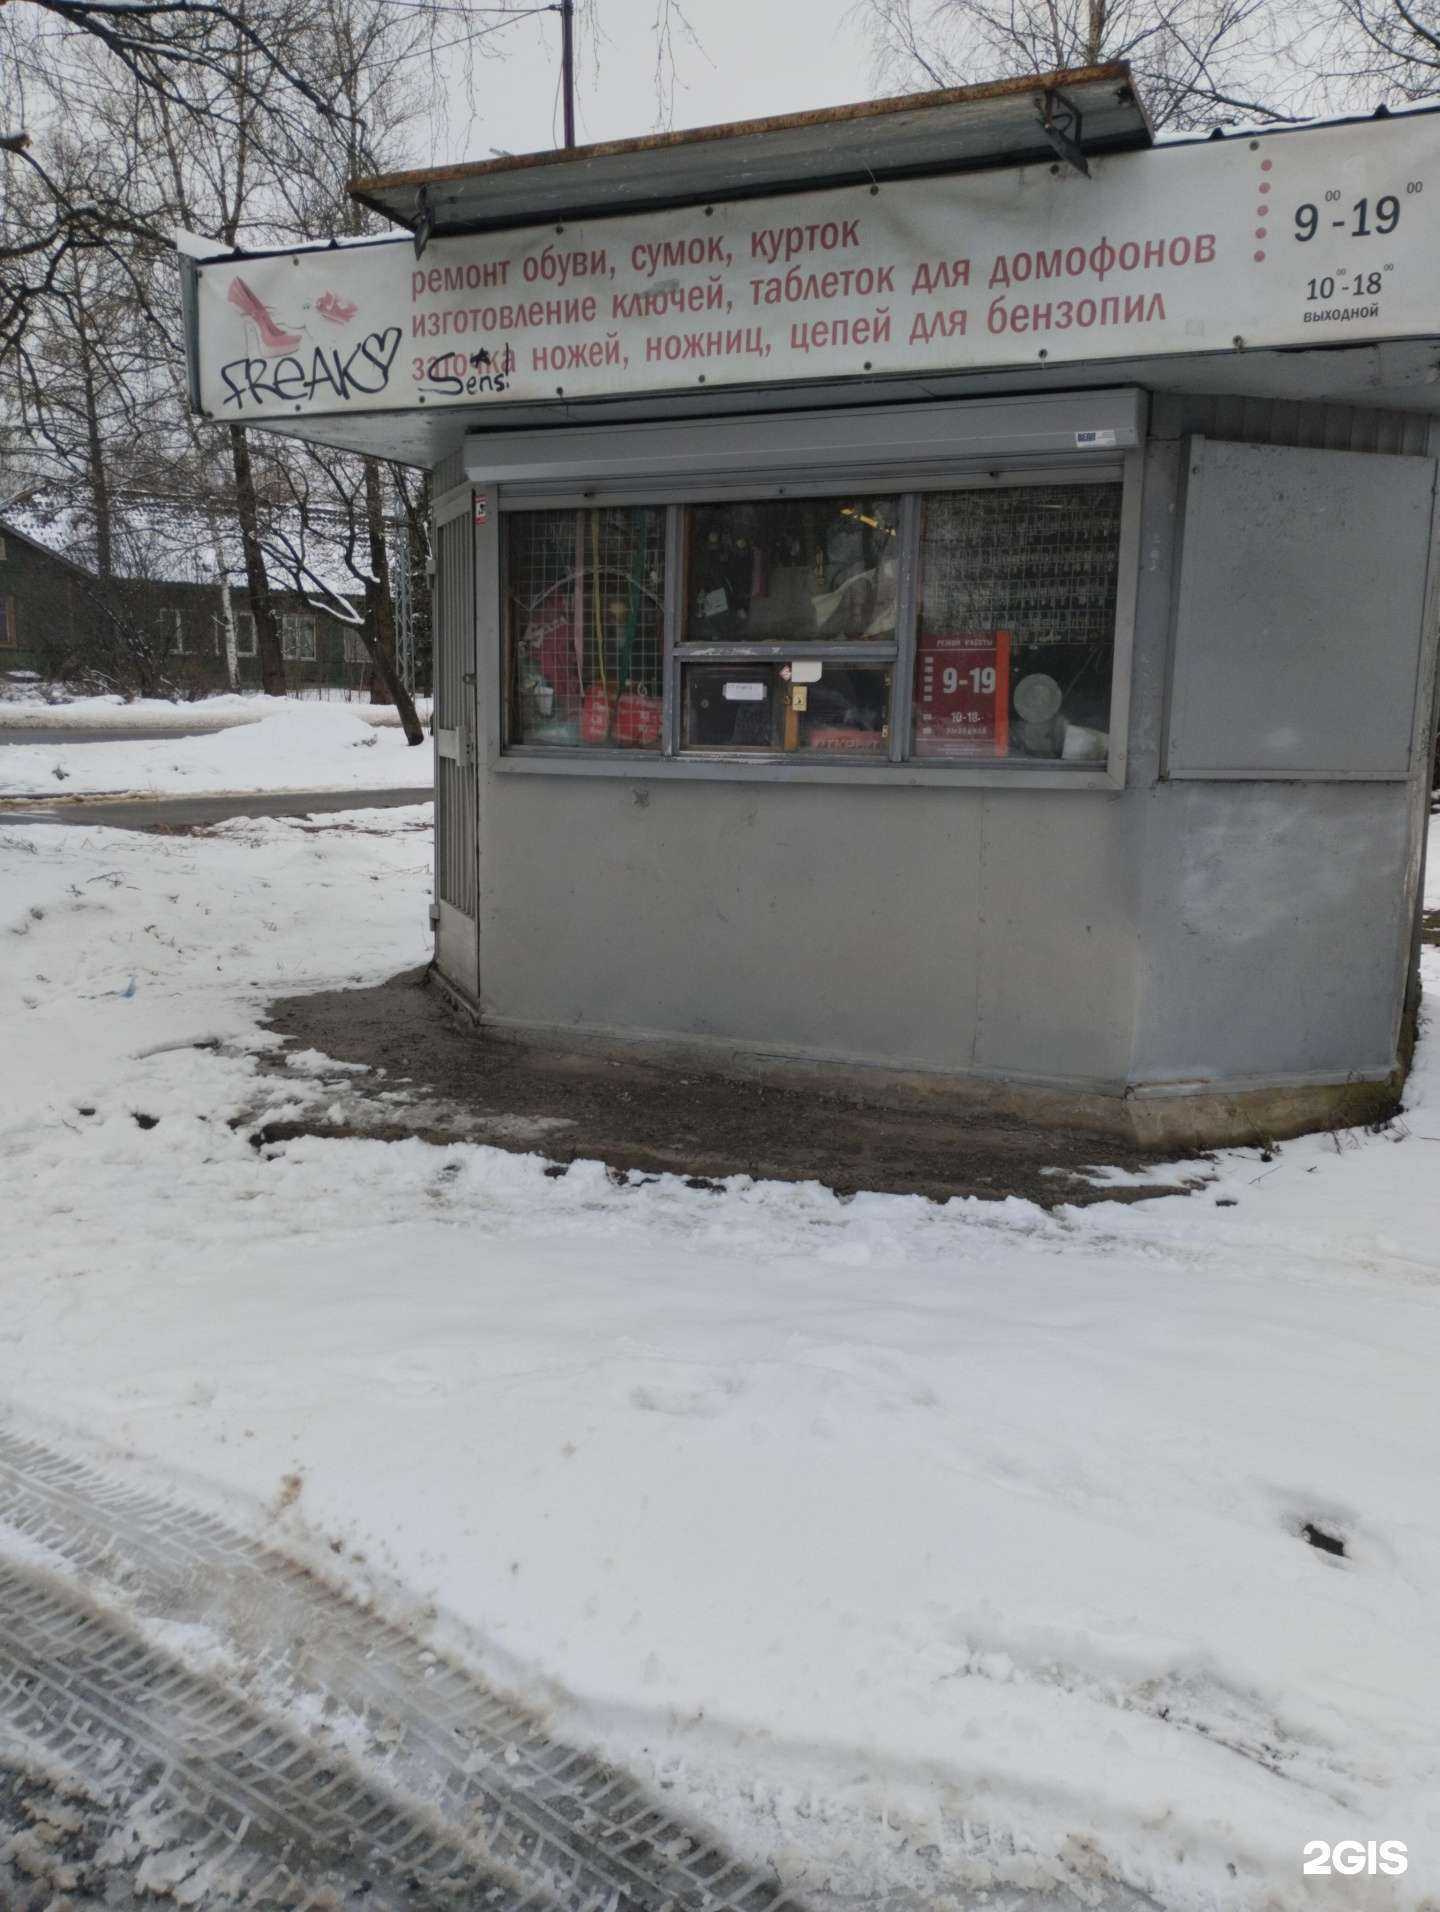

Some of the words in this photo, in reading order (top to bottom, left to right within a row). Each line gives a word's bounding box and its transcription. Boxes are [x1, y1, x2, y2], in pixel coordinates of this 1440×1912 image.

[411, 260, 511, 301] ремонт
[522, 245, 616, 287] обуви,
[631, 235, 733, 276] сумок,
[750, 219, 861, 263] курток
[411, 296, 597, 338] изготовление
[611, 278, 734, 319] ключей,
[749, 265, 896, 306] таблеток
[911, 257, 971, 296] для
[988, 232, 1217, 290] домофонов
[532, 331, 629, 372] ножей,
[644, 324, 773, 364] ножниц,
[789, 308, 892, 353] цепей
[908, 306, 968, 345] для
[986, 290, 1167, 335] бензопил
[1303, 303, 1380, 323] выходной
[942, 666, 997, 694] 9-19
